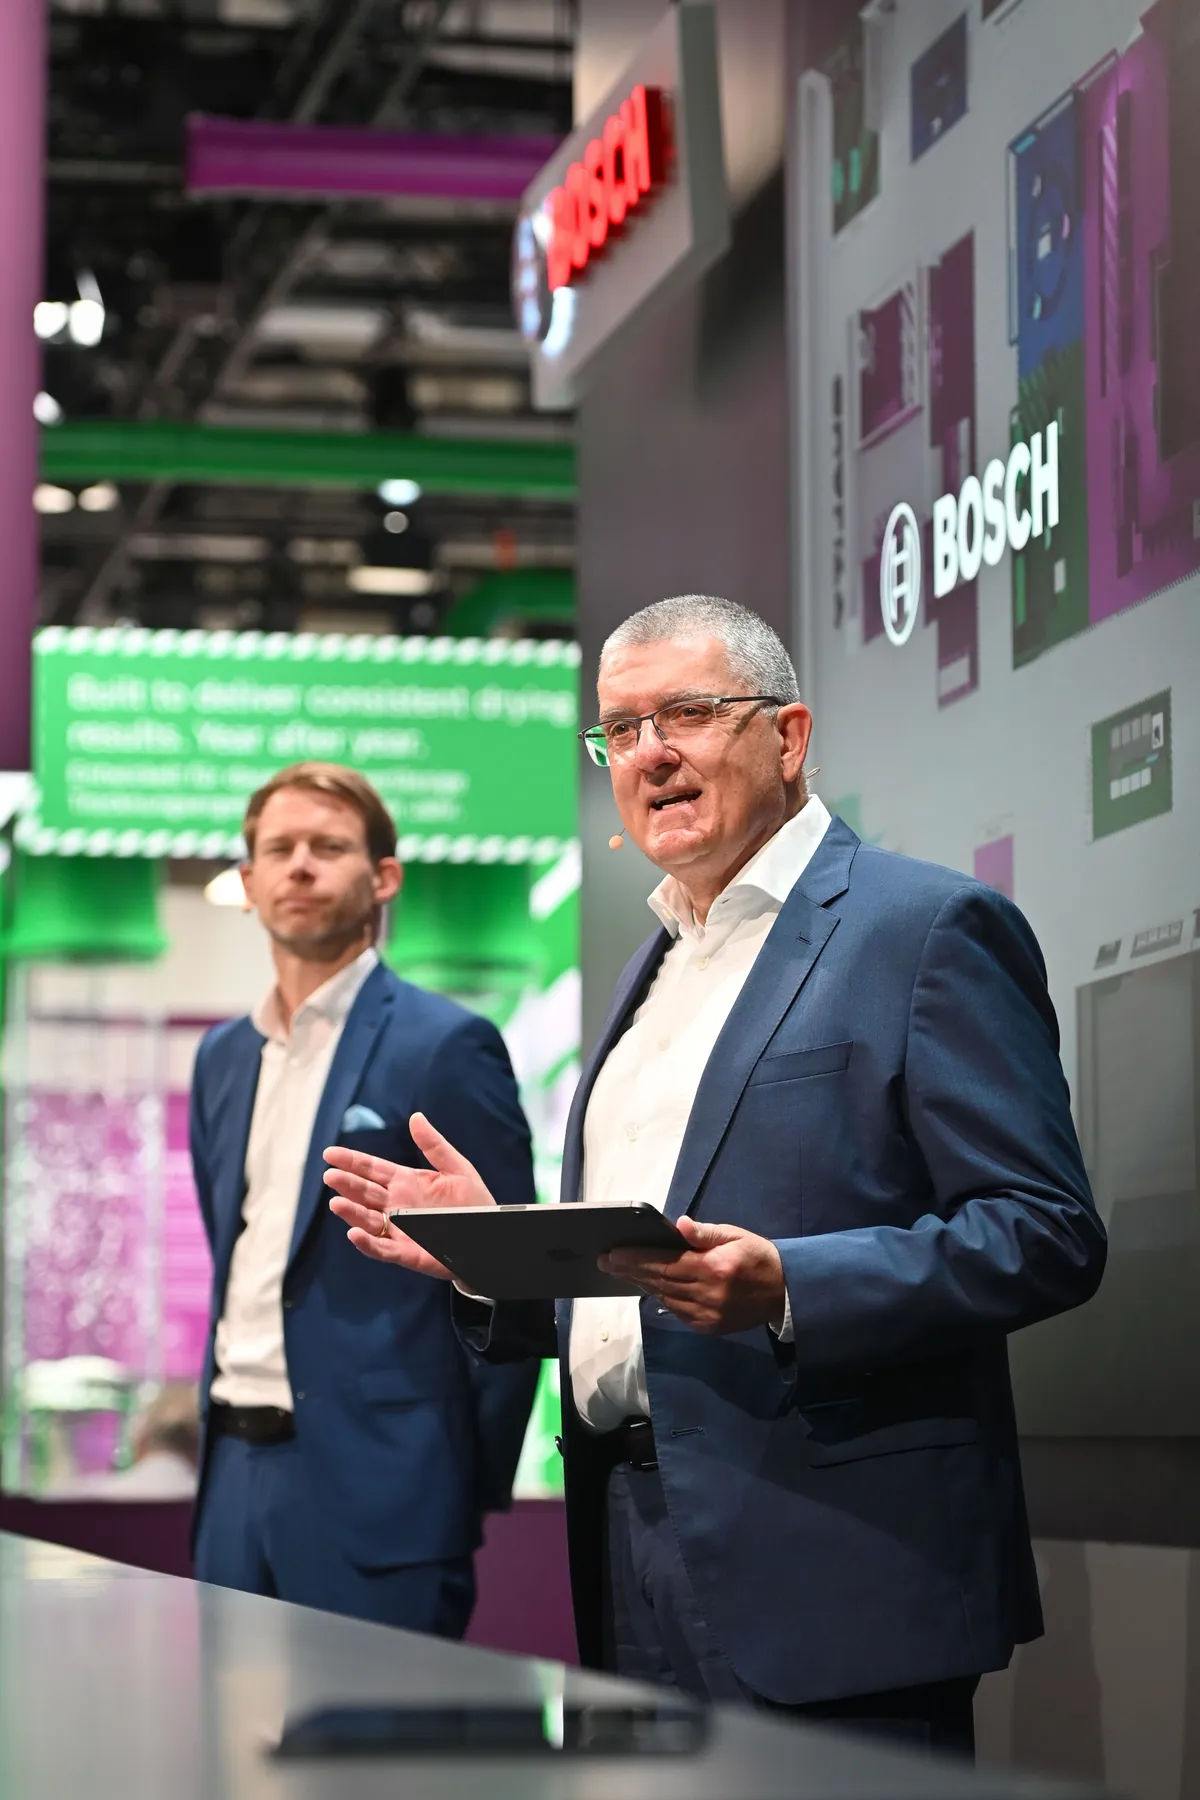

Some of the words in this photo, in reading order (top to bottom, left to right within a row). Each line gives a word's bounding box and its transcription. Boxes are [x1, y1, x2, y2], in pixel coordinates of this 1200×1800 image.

[546, 84, 652, 292] BOSCH
[933, 420, 1060, 599] BOSCH
[151, 677, 189, 712] to
[193, 677, 302, 714] deliver
